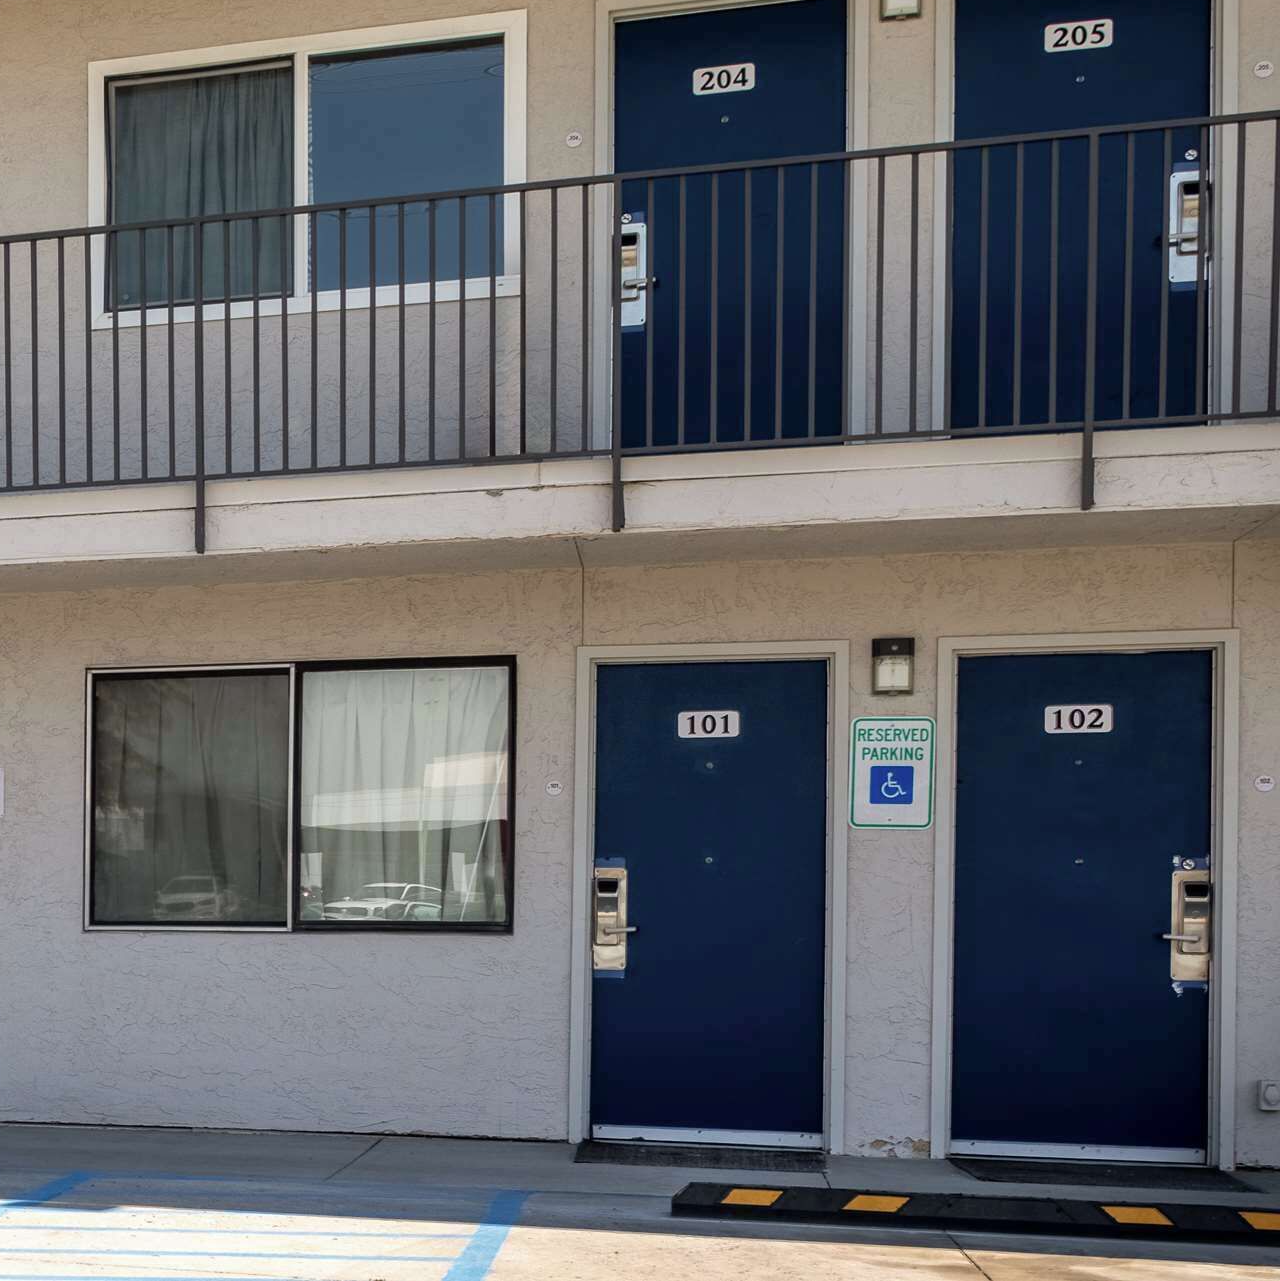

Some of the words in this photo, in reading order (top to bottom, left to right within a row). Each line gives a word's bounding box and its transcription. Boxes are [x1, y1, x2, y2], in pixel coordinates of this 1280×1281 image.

[1053, 23, 1106, 48] 205
[699, 67, 749, 92] 204
[686, 714, 731, 735] 101
[1052, 708, 1105, 730] 102
[857, 728, 929, 742] RESERVED
[862, 747, 924, 761] PARKING
